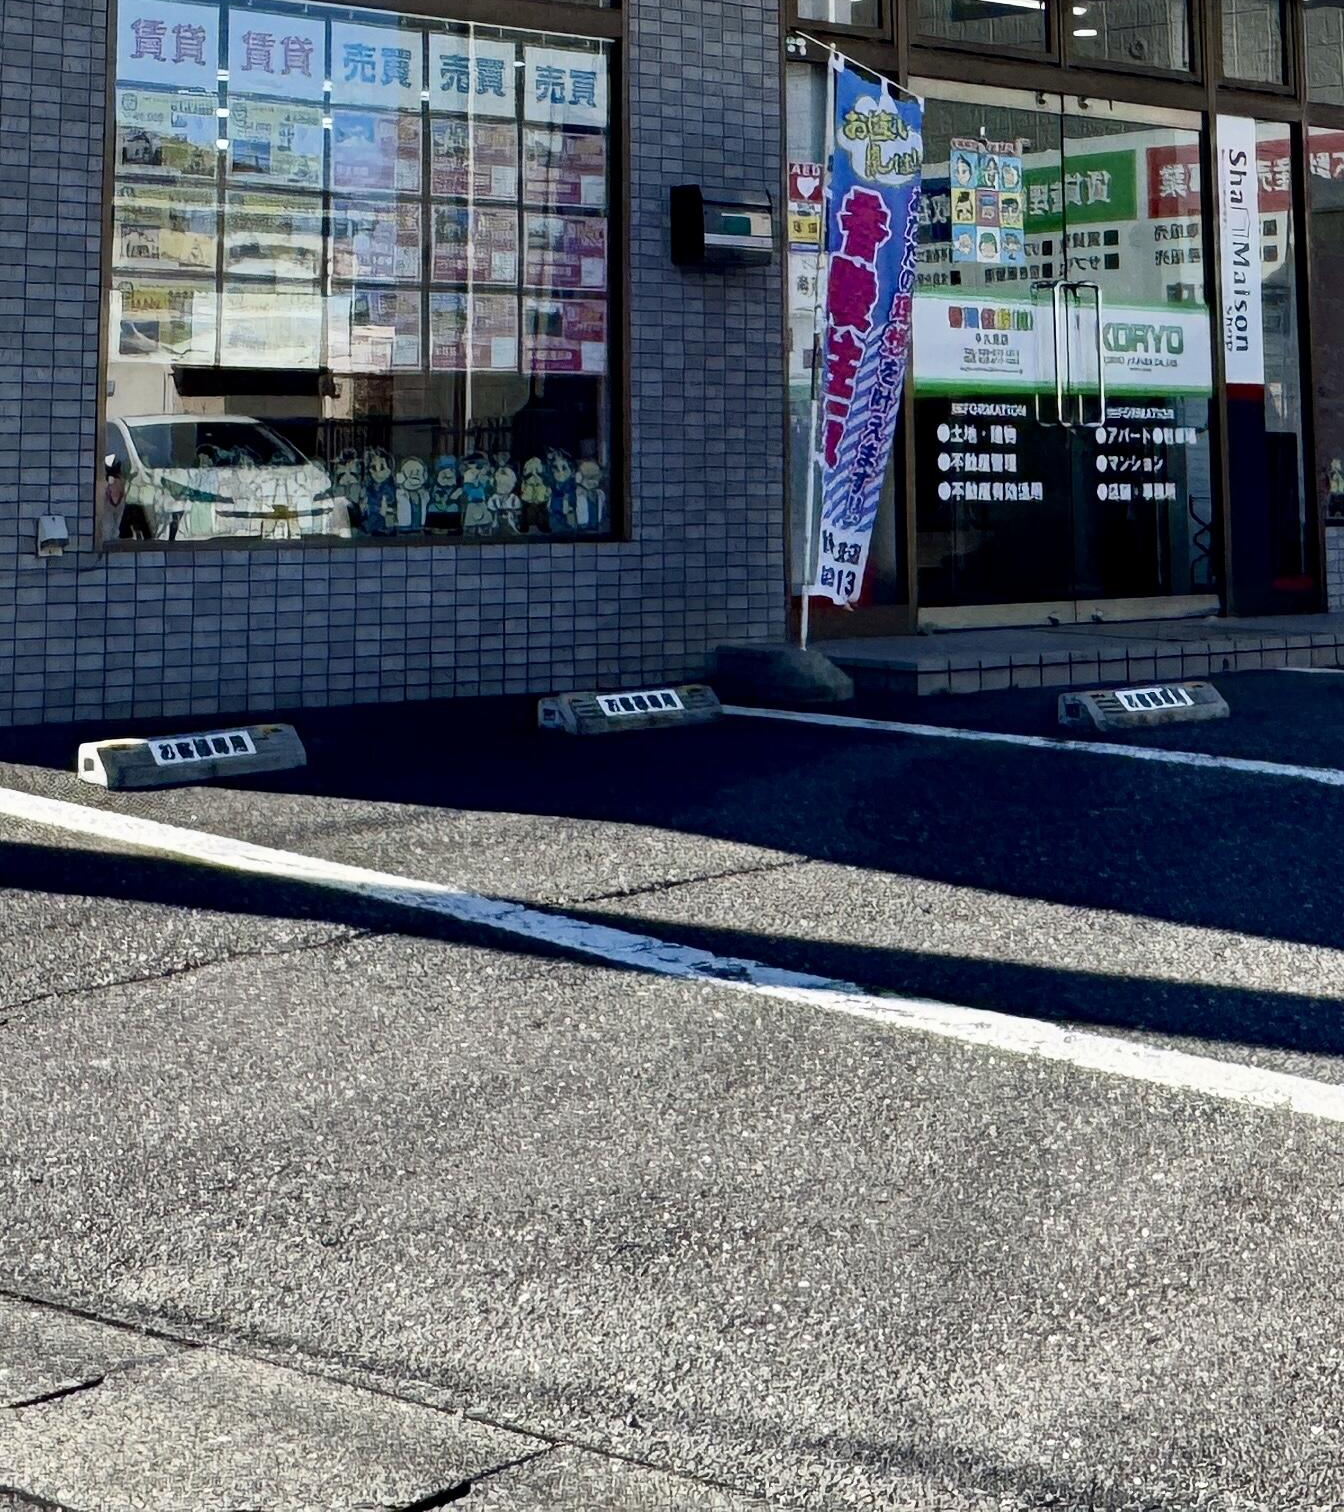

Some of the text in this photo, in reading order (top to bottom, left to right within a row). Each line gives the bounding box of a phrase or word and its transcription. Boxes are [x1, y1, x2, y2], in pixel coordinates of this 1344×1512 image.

[130, 17, 207, 67] 賃貸
[241, 30, 315, 78] 賃貸
[342, 41, 413, 89] 売買
[439, 52, 507, 99] 売買
[534, 63, 599, 110] 売買
[1232, 241, 1251, 352] Maison
